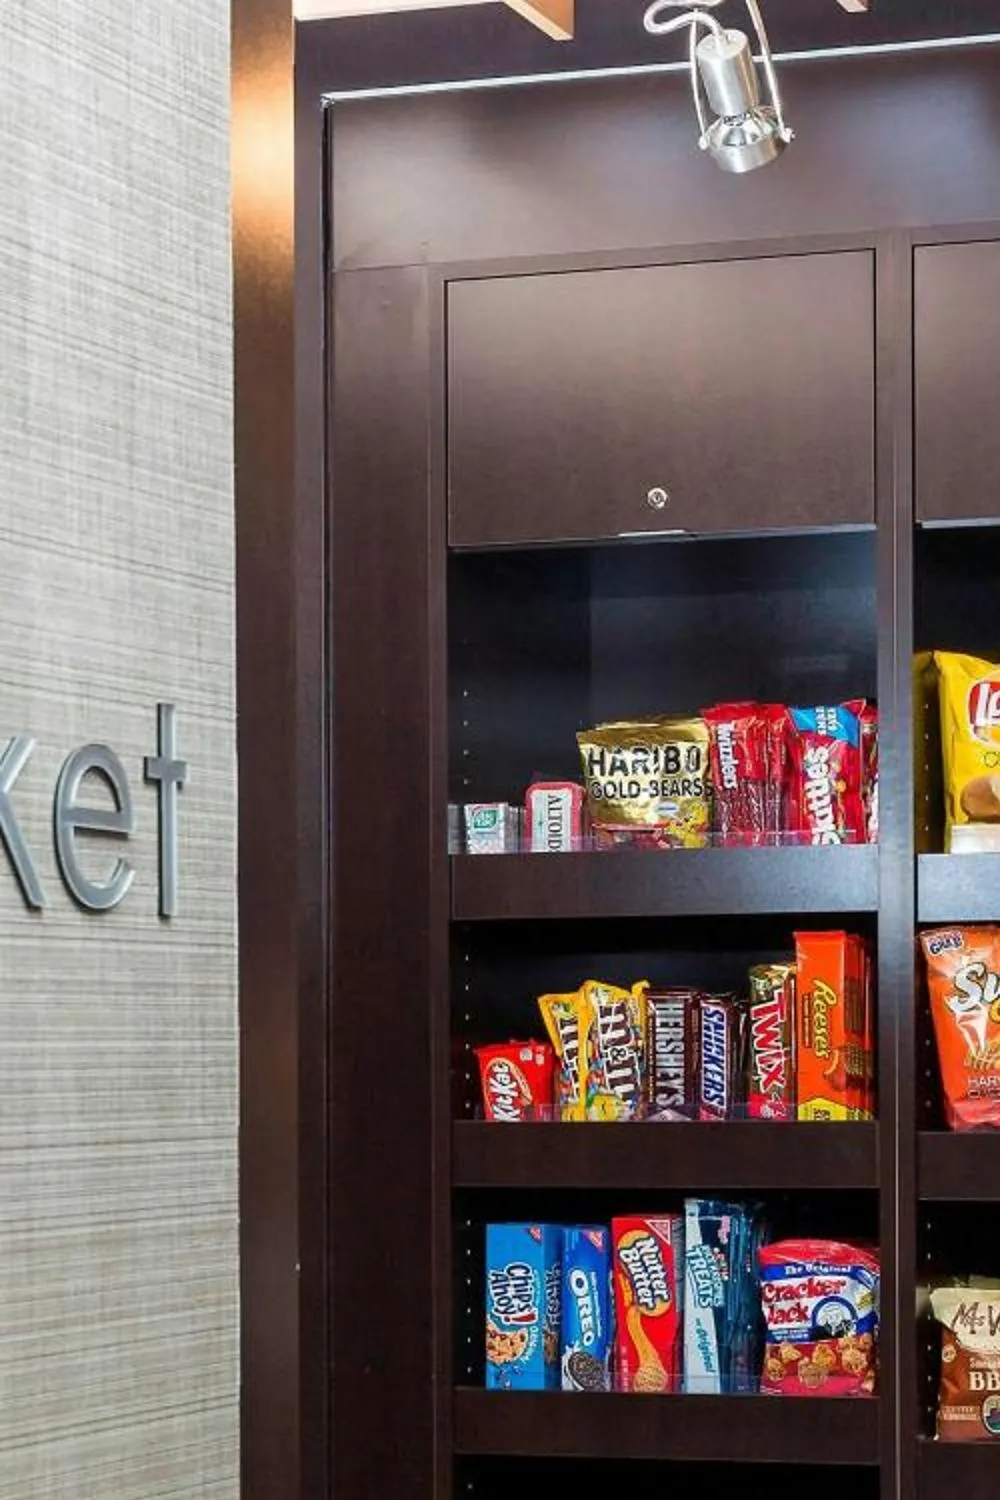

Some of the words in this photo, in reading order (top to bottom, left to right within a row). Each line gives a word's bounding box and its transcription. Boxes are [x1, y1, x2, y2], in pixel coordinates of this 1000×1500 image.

[588, 745, 701, 777] HARIBO
[717, 720, 739, 789] Twizzlers
[547, 794, 563, 853] ALTOID
[804, 746, 841, 845] Skittles
[751, 990, 786, 1094] TWIX
[813, 978, 838, 1059] Reese's
[655, 1000, 685, 1106] HERSHEY'S
[702, 1005, 726, 1107] SNICKERS
[505, 1264, 533, 1313] Chips
[619, 1247, 655, 1311] Butter
[635, 1237, 671, 1303] Nutter
[763, 1277, 847, 1303] Cracker
[570, 1268, 595, 1346] OREO
[767, 1302, 809, 1325] Jack
